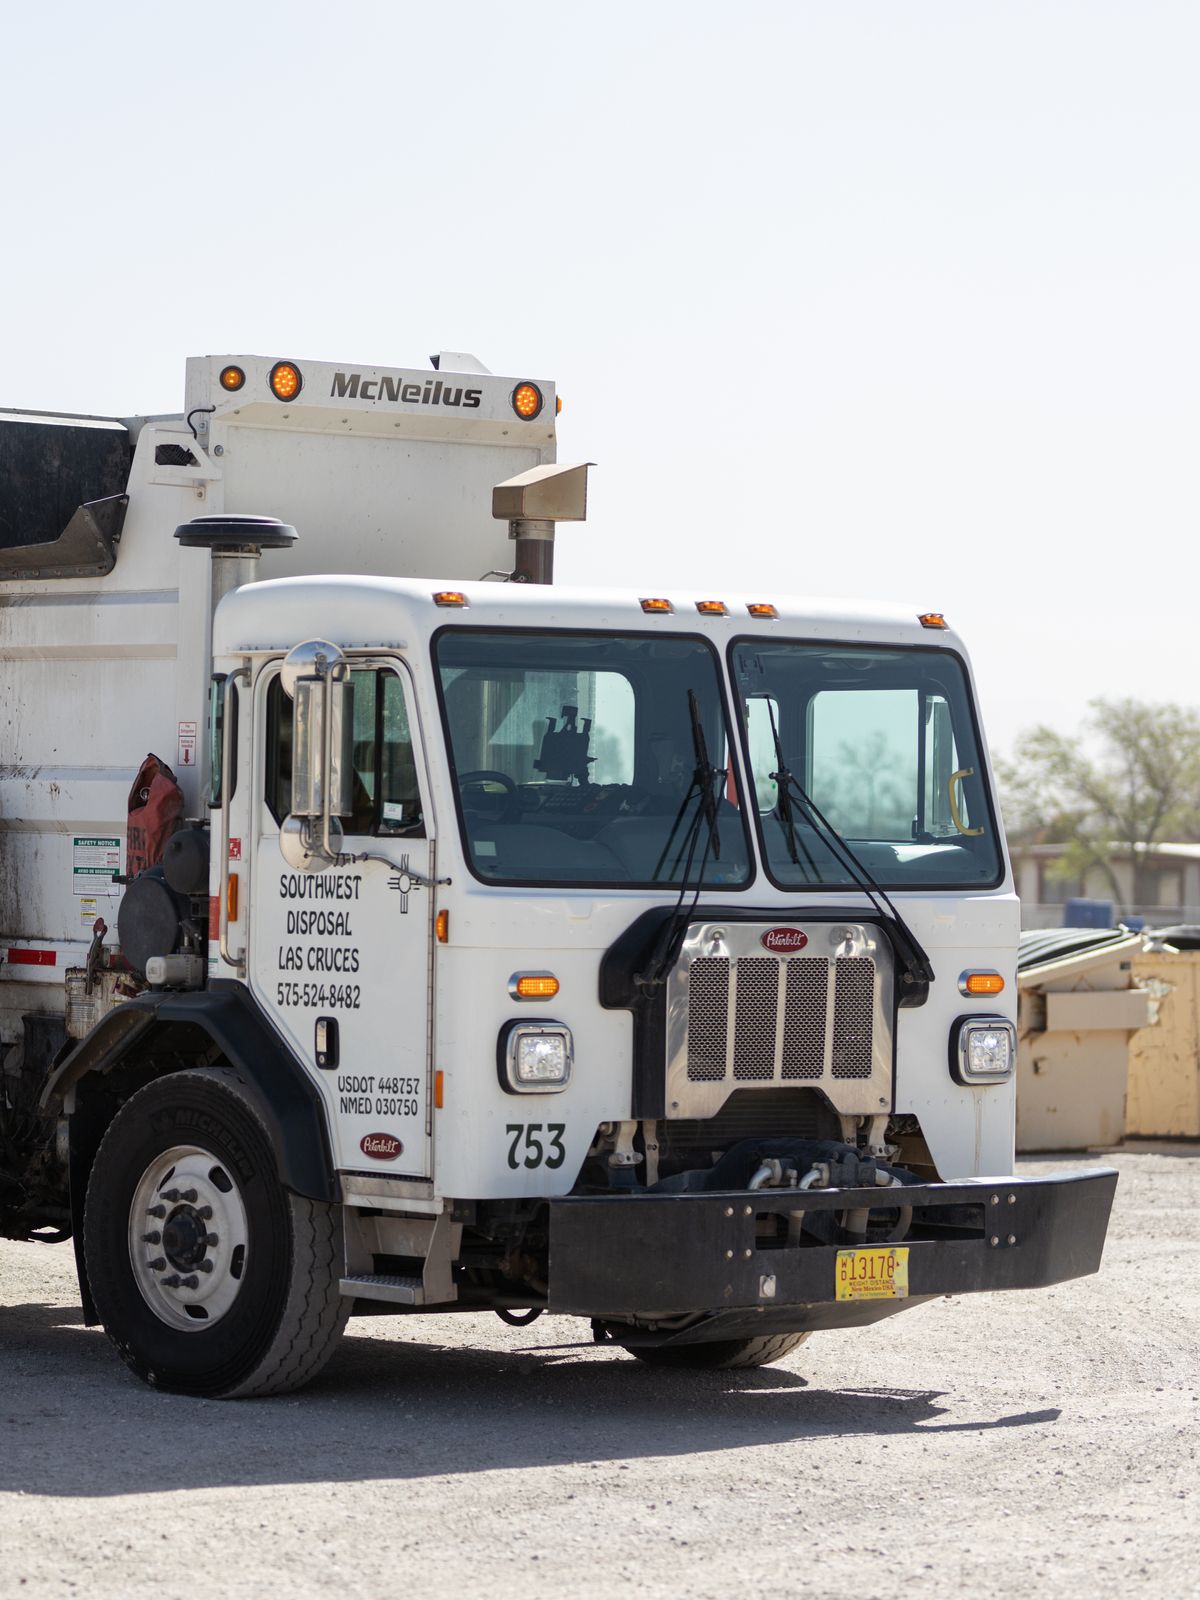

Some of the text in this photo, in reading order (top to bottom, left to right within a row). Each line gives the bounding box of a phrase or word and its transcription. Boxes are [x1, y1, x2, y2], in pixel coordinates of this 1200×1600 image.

[330, 372, 483, 408] McNeilus
[280, 874, 362, 900] SOUTHWEST
[287, 910, 352, 936] DISPOSAL
[767, 931, 805, 947] Peterbilt
[279, 946, 360, 973] LAS CRUCES
[277, 982, 361, 1009] 575-524-8482
[338, 1075, 420, 1095] USDOT 448757
[340, 1097, 418, 1116] NMED 030750
[175, 1109, 254, 1183] MICHELIN
[364, 1137, 399, 1153] Peterbilt
[506, 1123, 566, 1170] 753
[849, 1255, 895, 1280] 13178
